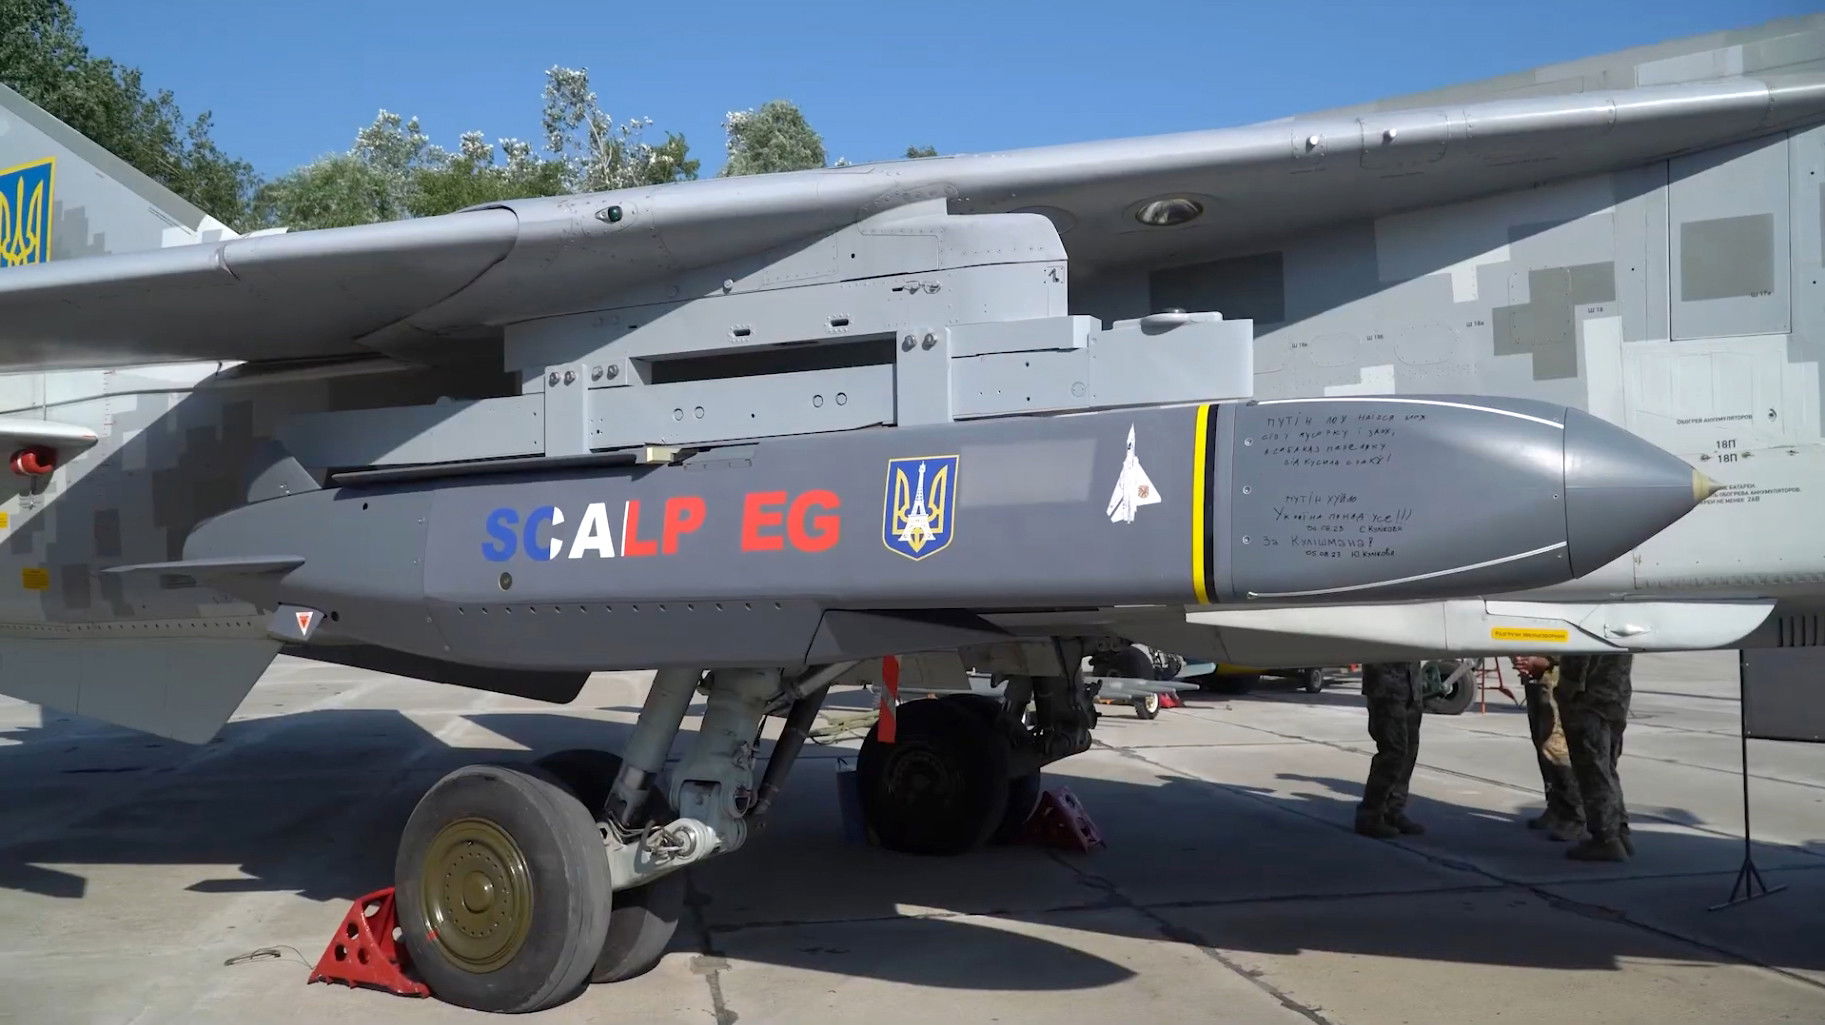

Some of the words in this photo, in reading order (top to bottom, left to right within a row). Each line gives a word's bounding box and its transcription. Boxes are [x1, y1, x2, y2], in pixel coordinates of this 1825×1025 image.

[1267, 411, 1312, 428] ПУТІН
[481, 495, 707, 563] SCALP
[741, 489, 841, 554] EG
